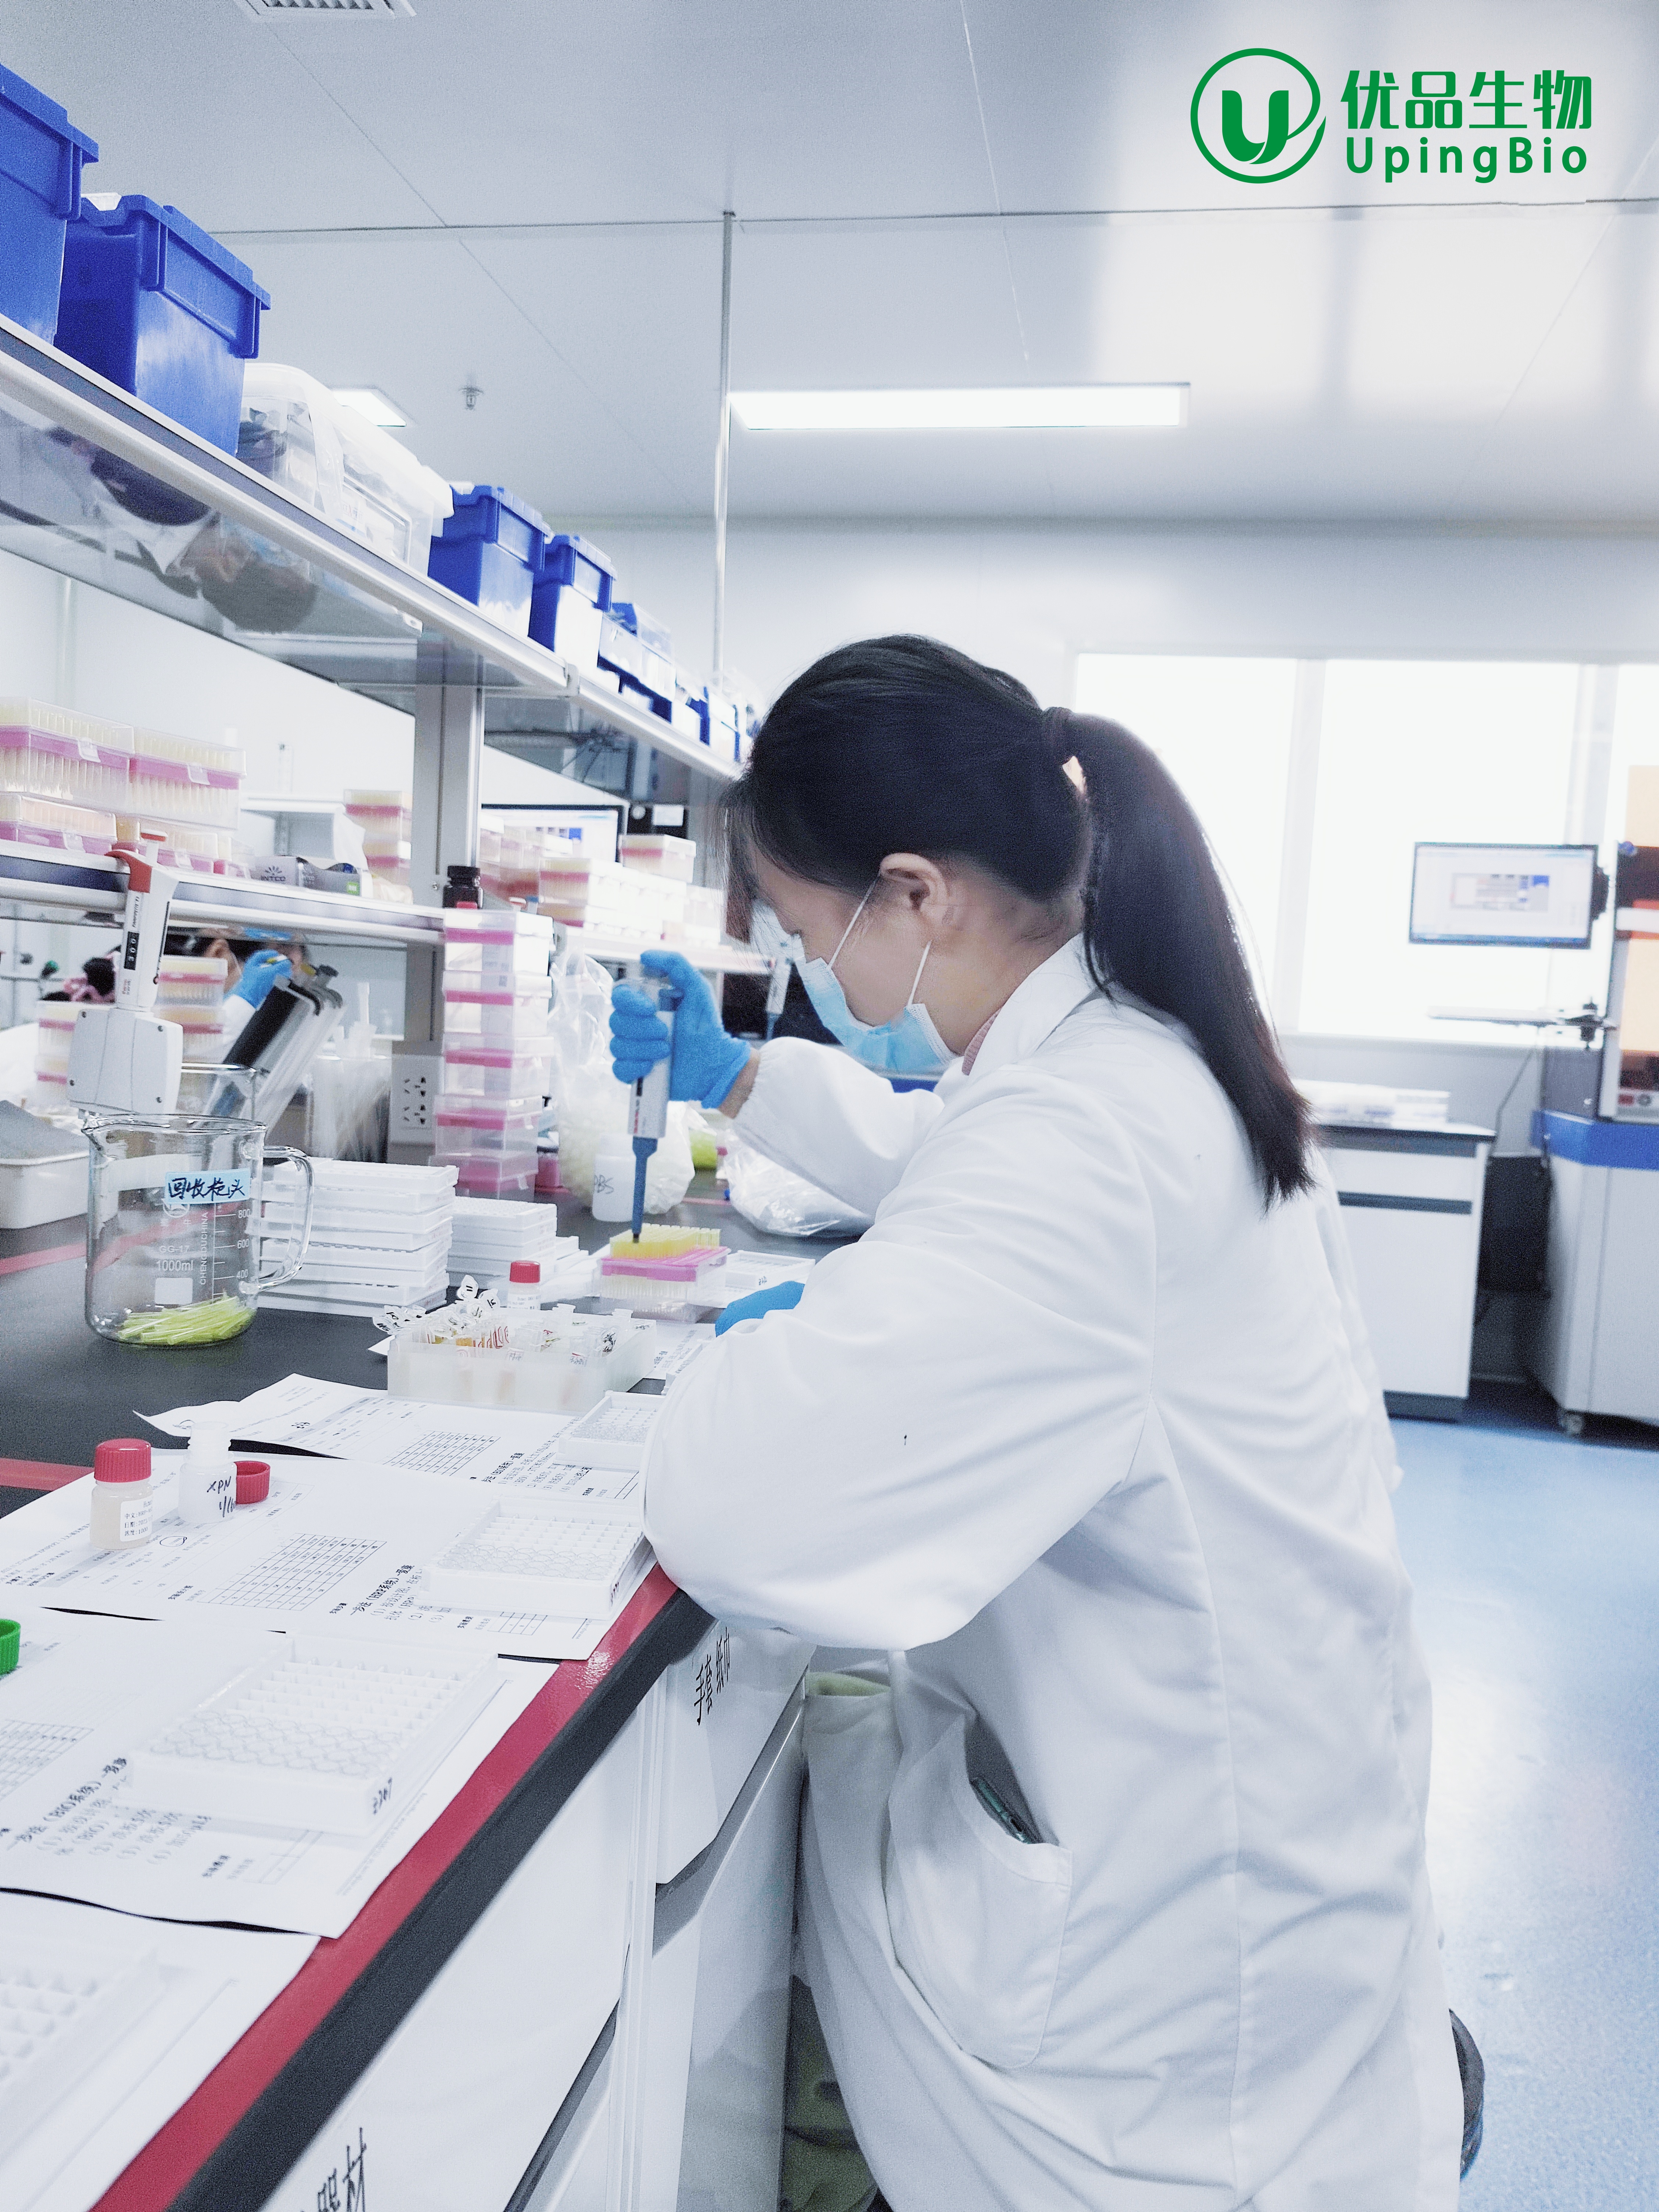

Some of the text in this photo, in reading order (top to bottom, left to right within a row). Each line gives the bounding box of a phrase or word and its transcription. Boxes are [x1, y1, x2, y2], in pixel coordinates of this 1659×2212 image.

[238, 1208, 250, 1219] 800
[237, 1238, 250, 1249] 600
[156, 1260, 194, 1271] 1000ml
[236, 1269, 249, 1280] 400
